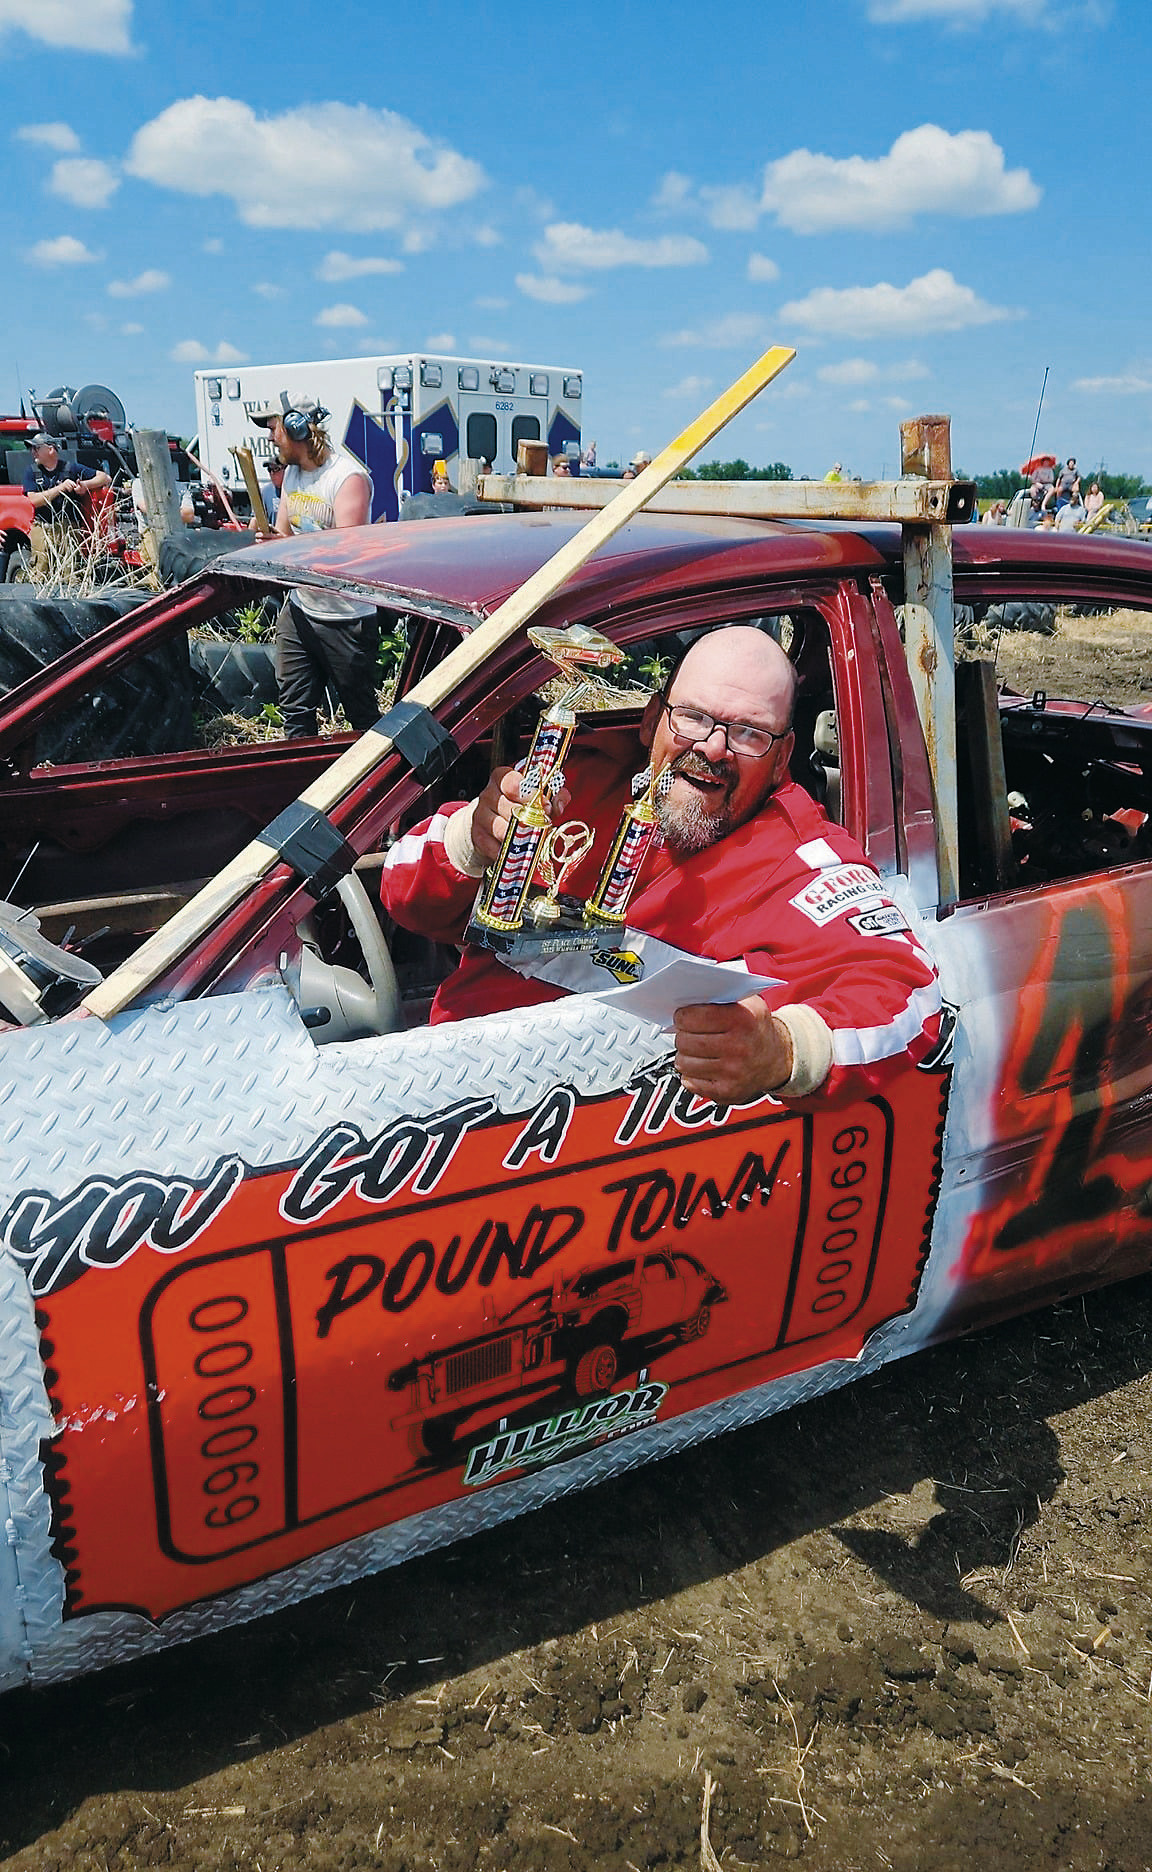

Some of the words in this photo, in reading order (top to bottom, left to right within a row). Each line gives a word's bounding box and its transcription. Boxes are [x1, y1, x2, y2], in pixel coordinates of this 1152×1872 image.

[495, 401, 514, 411] 6282
[816, 884, 867, 913] RACING
[866, 883, 886, 892] GEA
[4, 1157, 246, 1297] YOU
[279, 1097, 497, 1225] GOT
[502, 1086, 577, 1171] A
[614, 1052, 775, 1146] TIC
[316, 1205, 586, 1339] POUND
[602, 1140, 791, 1252] TOWN
[811, 1125, 870, 1324] 000069
[188, 1295, 261, 1529] 000069
